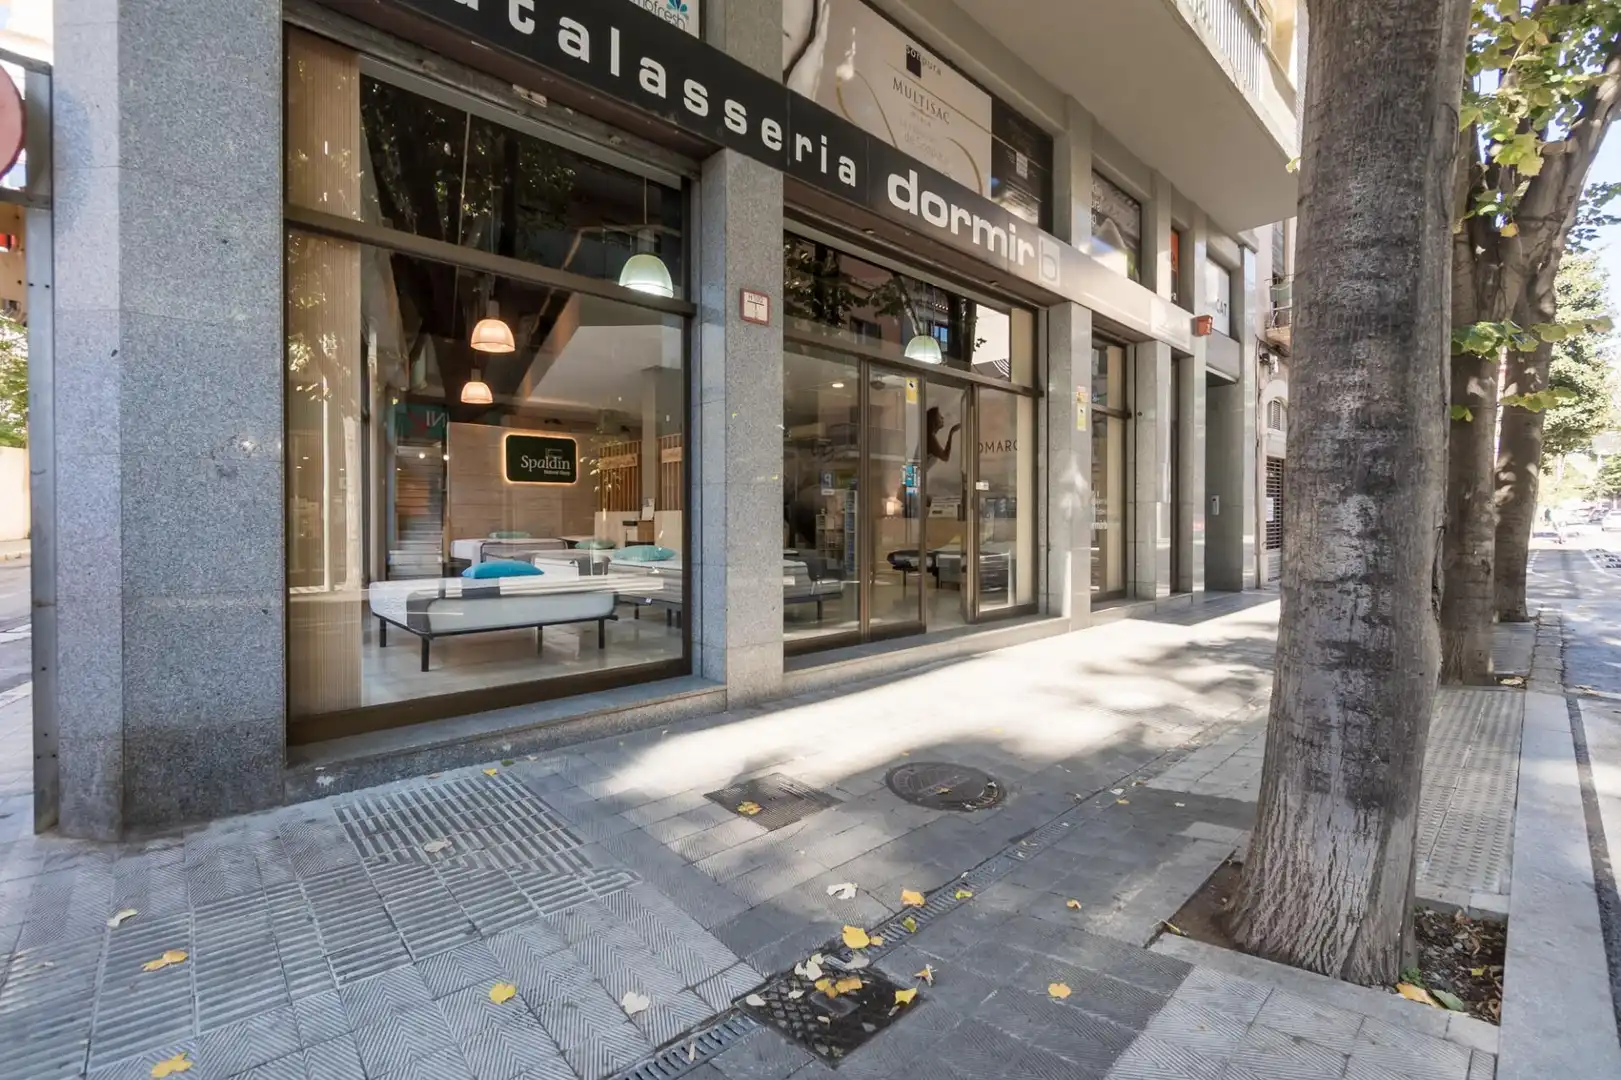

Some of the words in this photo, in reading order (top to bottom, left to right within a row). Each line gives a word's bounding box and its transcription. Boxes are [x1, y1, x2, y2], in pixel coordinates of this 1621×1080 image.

[892, 77, 950, 125] MULTISAC
[454, 0, 857, 187] talasseria
[888, 169, 1035, 267] dormir
[521, 454, 571, 473] Spaldin
